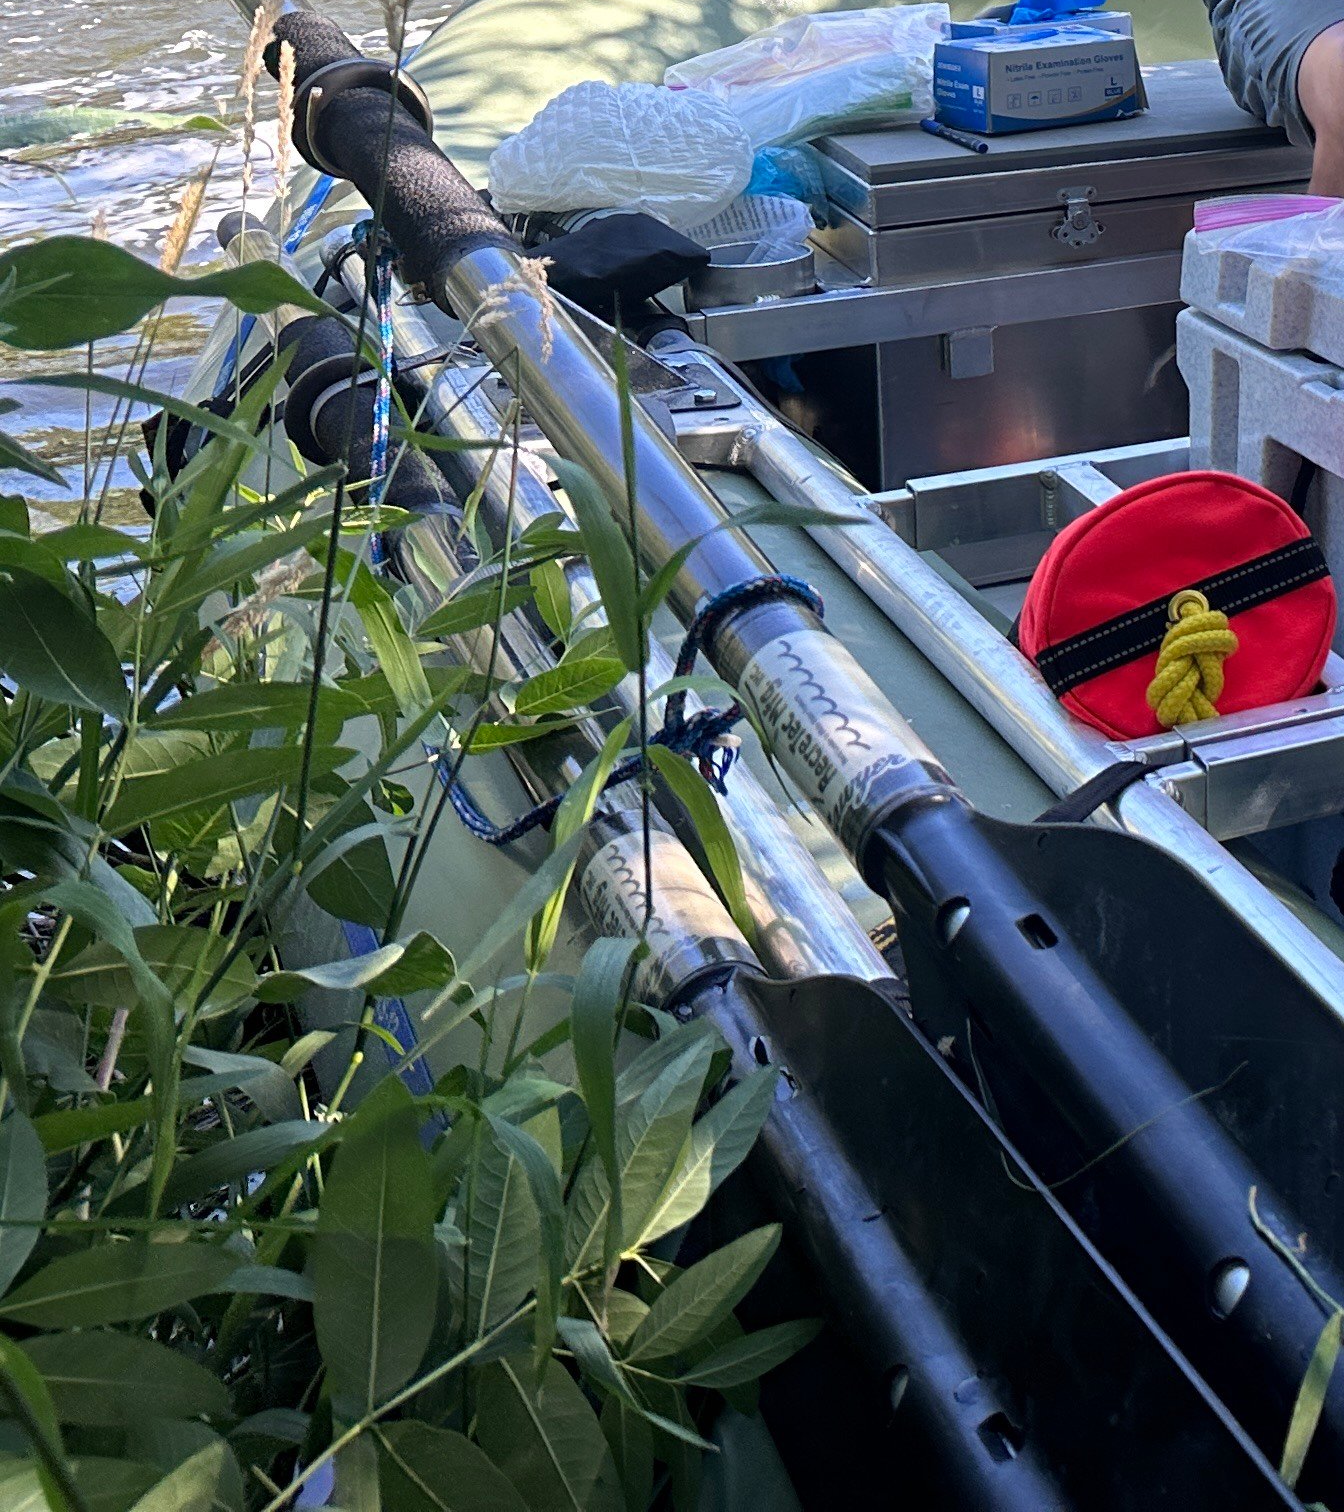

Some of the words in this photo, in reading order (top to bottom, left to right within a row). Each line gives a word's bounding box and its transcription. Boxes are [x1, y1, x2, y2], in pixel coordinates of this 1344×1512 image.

[1005, 62, 1033, 73] Nitrile
[1036, 57, 1091, 70] Examination
[1094, 53, 1124, 63] Gloves
[1110, 76, 1117, 86] L
